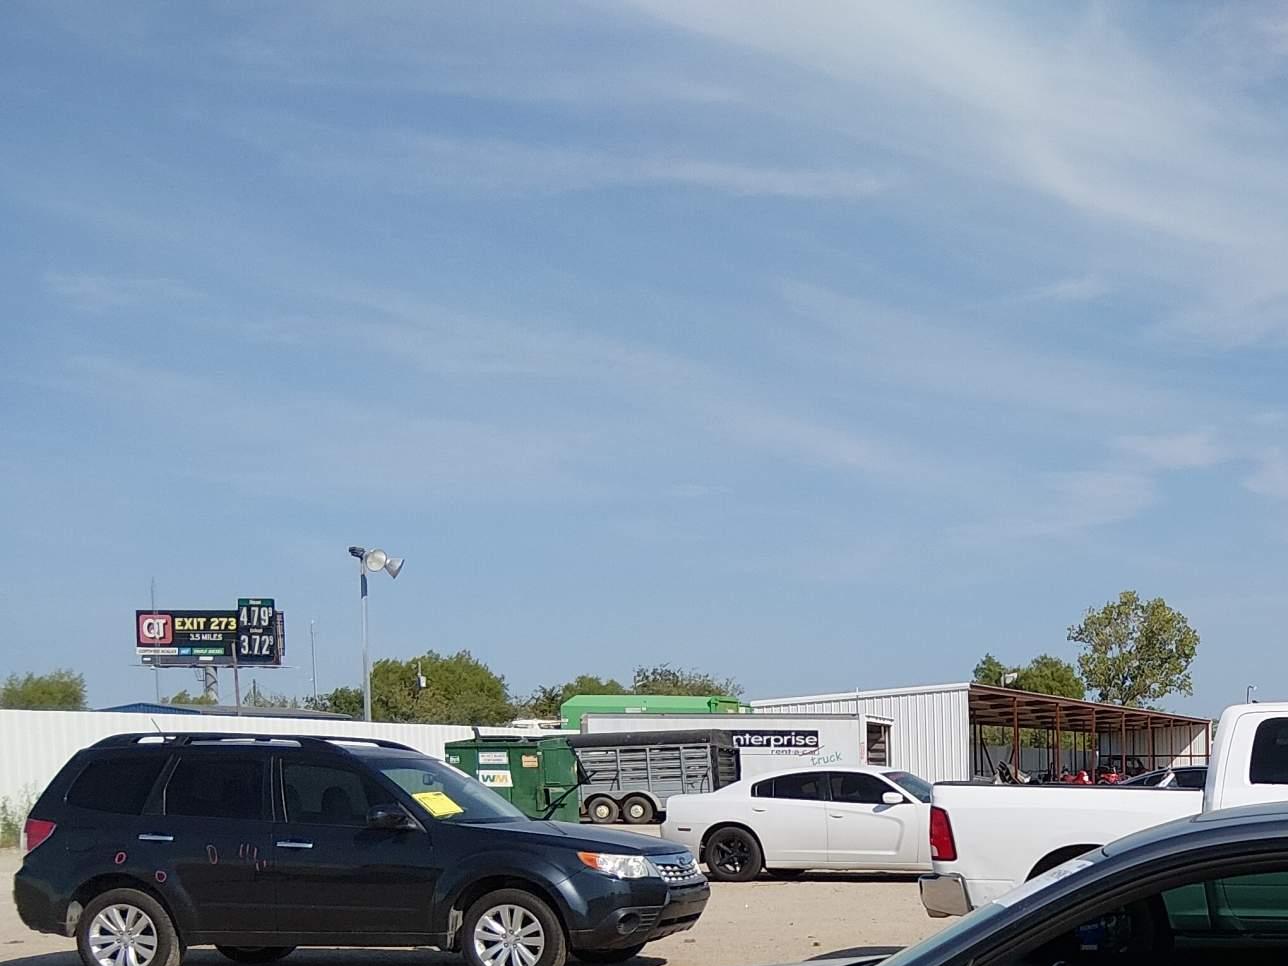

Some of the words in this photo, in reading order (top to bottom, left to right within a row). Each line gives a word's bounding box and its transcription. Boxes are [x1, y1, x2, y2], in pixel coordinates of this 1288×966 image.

[143, 618, 166, 640] QT
[175, 617, 207, 630] EXIT
[210, 617, 237, 631] 273
[201, 633, 223, 641] MILES
[732, 732, 818, 747] nterprise
[811, 751, 842, 766] truck
[481, 774, 508, 785] WM
